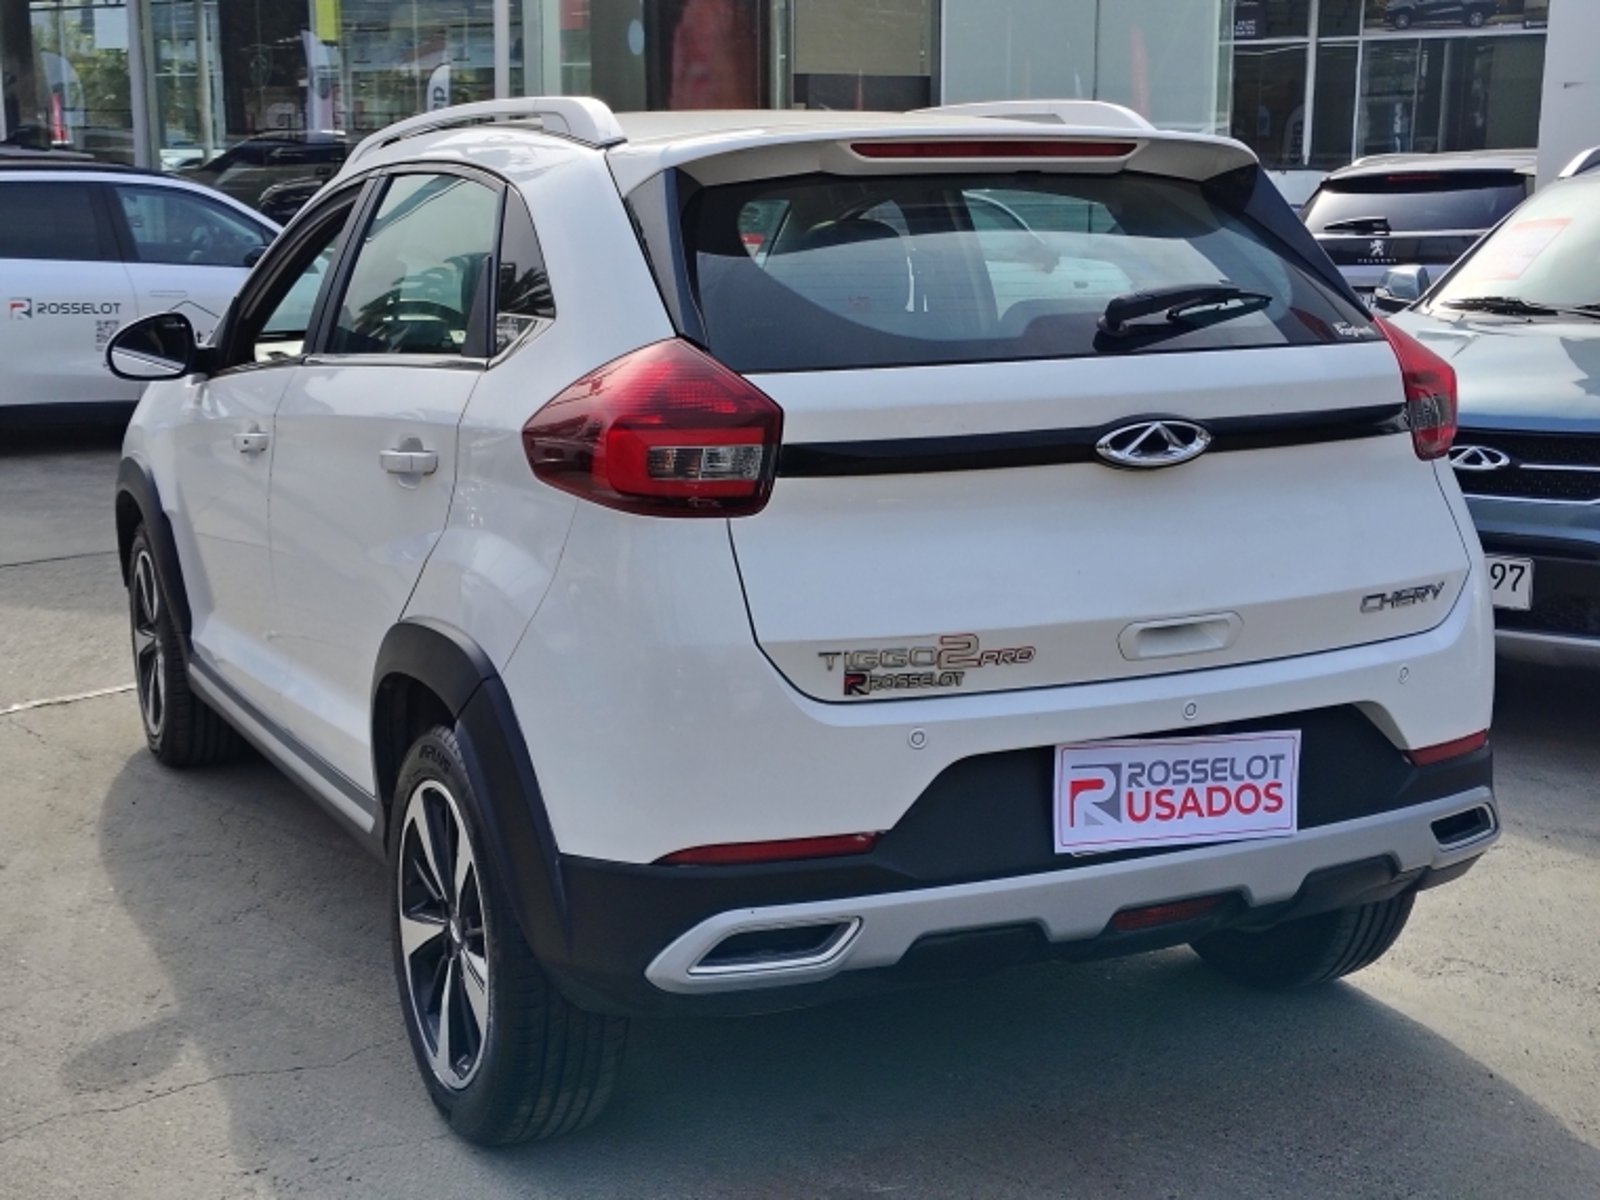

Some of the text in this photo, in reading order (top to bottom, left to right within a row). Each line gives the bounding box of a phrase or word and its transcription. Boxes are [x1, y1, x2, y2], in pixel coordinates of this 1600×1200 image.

[36, 302, 121, 315] ROSSELOT
[1490, 563, 1525, 592] 97
[1359, 581, 1446, 614] CHERY
[978, 646, 1037, 668] PRO
[869, 671, 965, 692] ROSSELOT
[1127, 754, 1286, 789] ROSSELOT
[1126, 781, 1285, 824] USADOS
